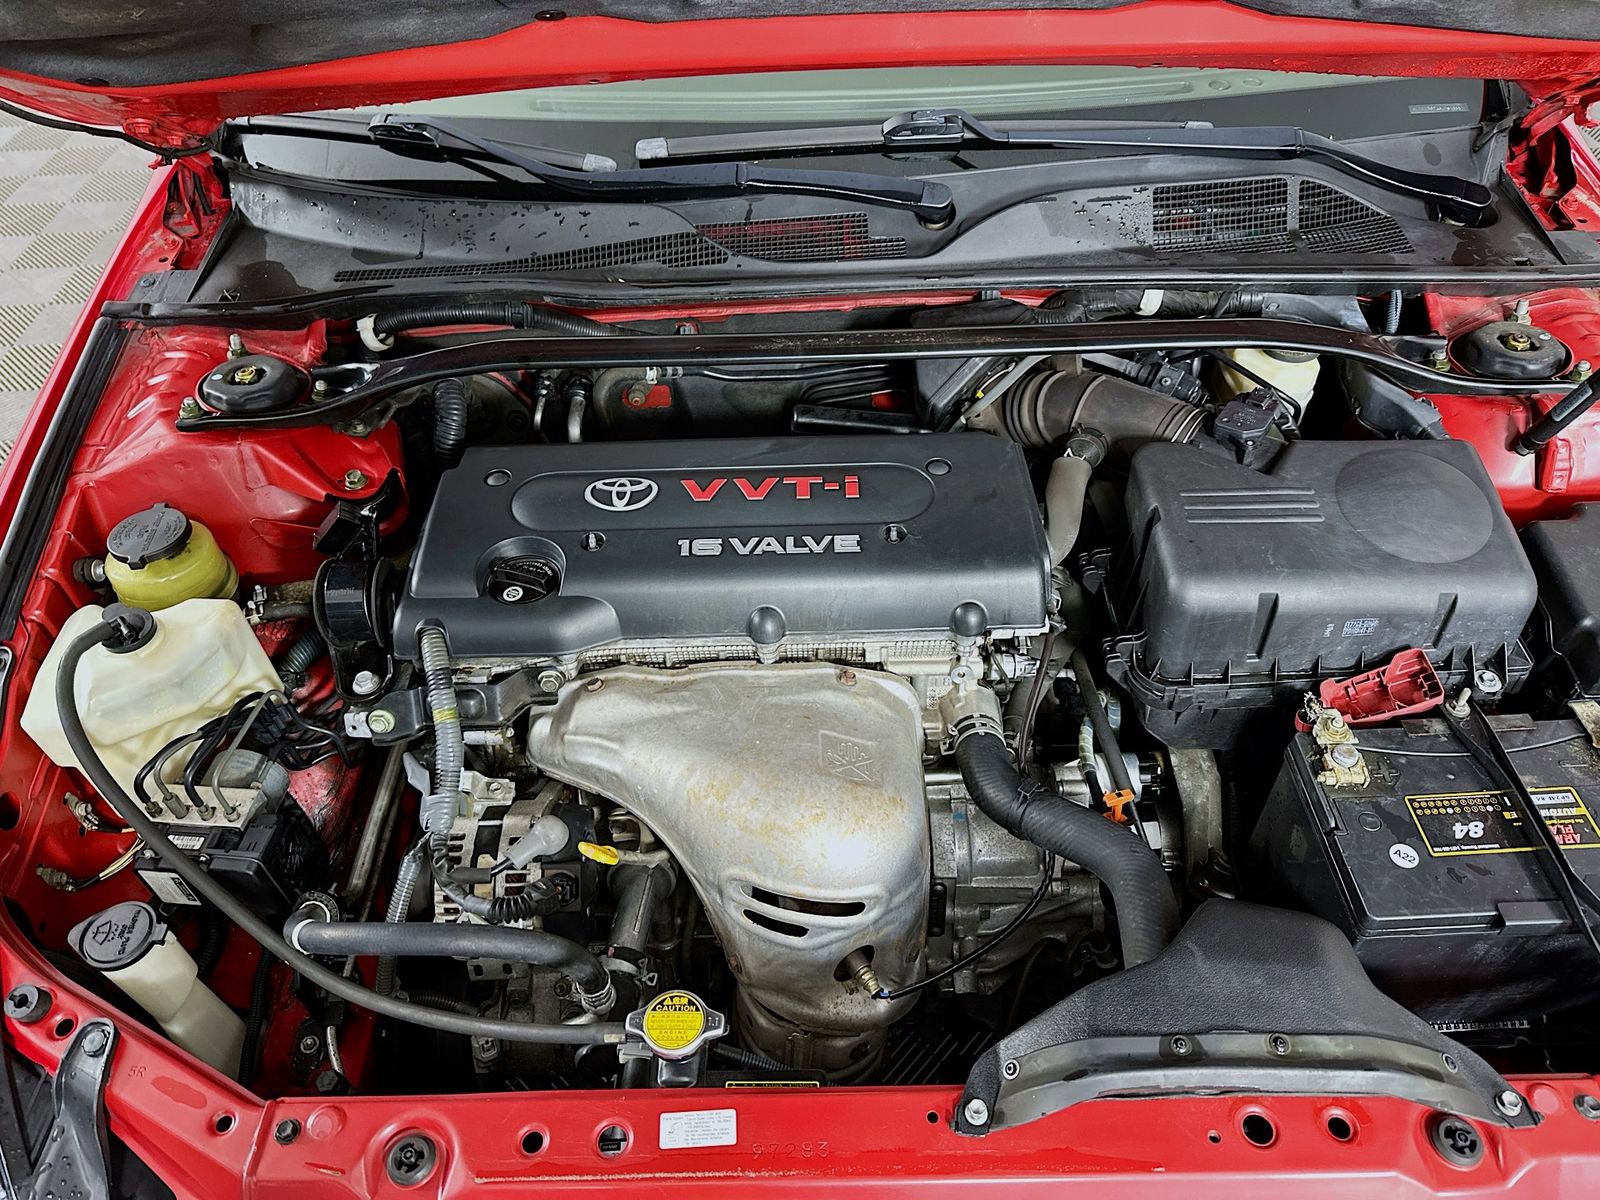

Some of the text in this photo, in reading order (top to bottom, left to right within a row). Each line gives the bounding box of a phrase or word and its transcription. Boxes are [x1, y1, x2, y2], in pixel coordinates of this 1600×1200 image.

[680, 475, 860, 502] VVT-i
[677, 534, 862, 556] 16 VALVE
[1452, 821, 1485, 840] 84
[1393, 849, 1416, 865] A22
[655, 1004, 697, 1012] CAUTION
[752, 1141, 830, 1160] 97283
